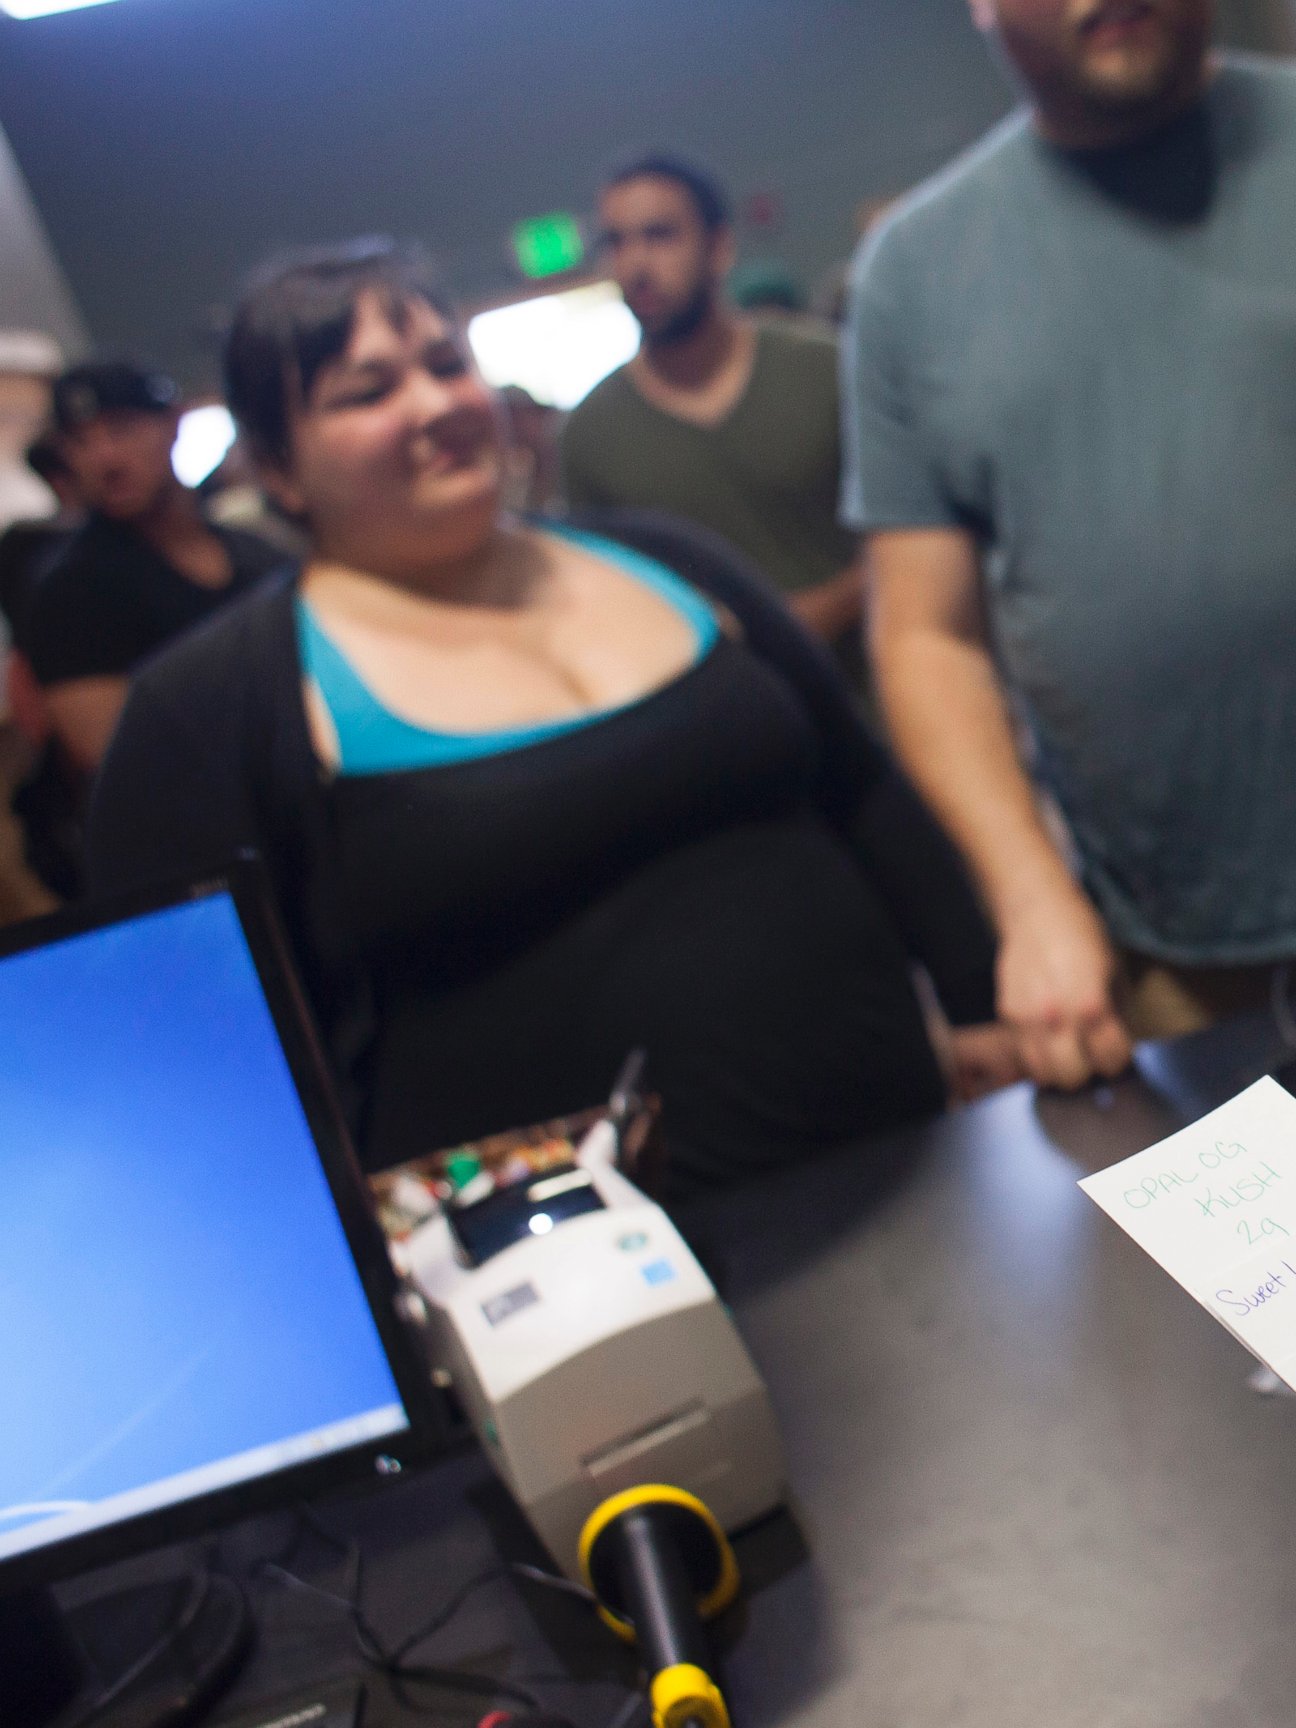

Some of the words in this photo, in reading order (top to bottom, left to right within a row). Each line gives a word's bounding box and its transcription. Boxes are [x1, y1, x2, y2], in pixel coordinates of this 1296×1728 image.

[1124, 1170, 1199, 1209] OPAL
[1199, 1141, 1248, 1169] OG
[1194, 1161, 1283, 1218] KUSH
[1237, 1217, 1291, 1245] 2g
[1215, 1273, 1284, 1317] Sweet
